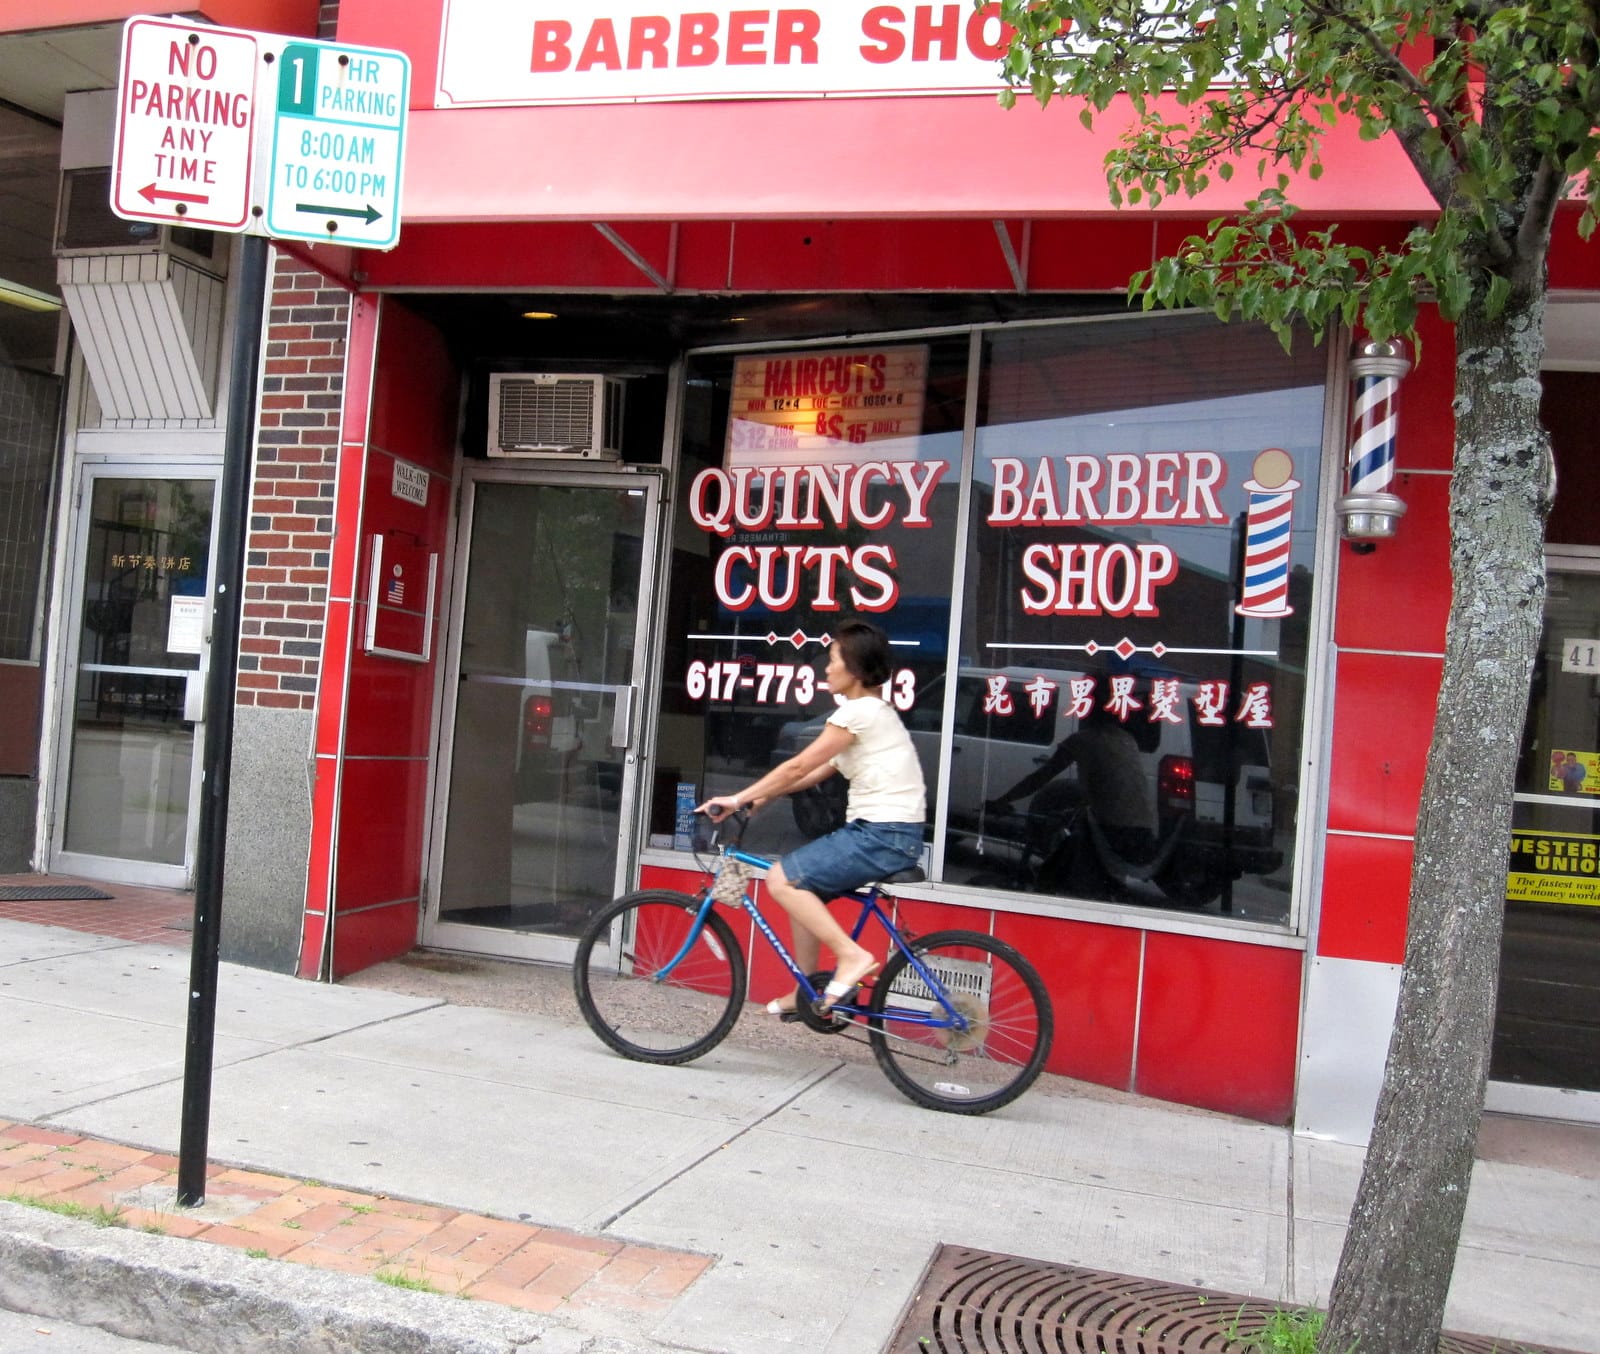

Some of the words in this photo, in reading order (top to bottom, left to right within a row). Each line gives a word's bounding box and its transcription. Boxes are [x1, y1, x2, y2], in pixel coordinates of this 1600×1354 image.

[168, 40, 217, 80] NO
[530, 9, 821, 74] BARBER
[292, 57, 304, 105] 1
[348, 58, 380, 84] HR
[130, 79, 248, 129] PARKING
[322, 86, 396, 117] PARKING
[161, 126, 213, 153] ANY
[154, 153, 217, 185] TIME
[285, 164, 307, 188] TO
[763, 353, 887, 397] HAIRCUTS
[396, 463, 427, 488] WALK-INS
[396, 479, 424, 502] WELCOME
[986, 451, 1230, 527] BARBER
[689, 460, 950, 537] QUINCY
[714, 545, 899, 613] CUTS
[1021, 543, 1179, 617] SHOP
[983, 675, 1274, 728] 昆市男界髮型屋
[1506, 887, 1527, 895] end
[1530, 889, 1565, 900] money
[1516, 876, 1535, 886] The
[1536, 878, 1573, 889] fastest
[1576, 882, 1598, 893] way
